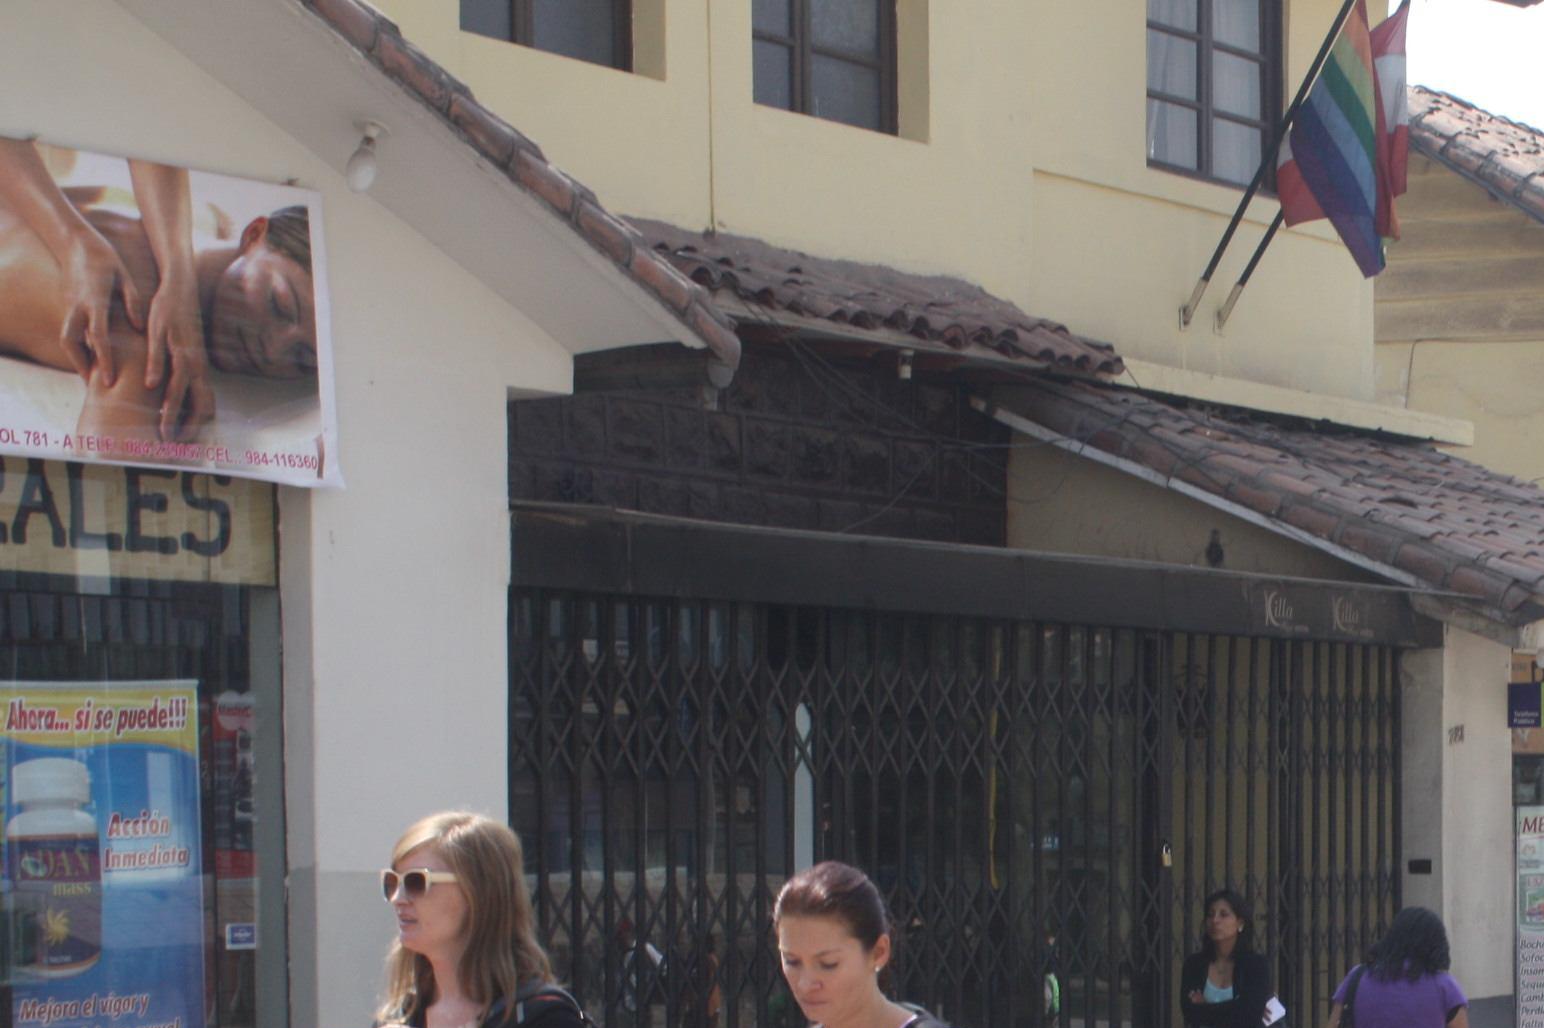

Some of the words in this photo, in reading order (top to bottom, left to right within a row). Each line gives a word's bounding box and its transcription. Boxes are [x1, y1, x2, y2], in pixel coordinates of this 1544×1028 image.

[24, 430, 48, 447] 781
[63, 434, 73, 448] A
[246, 450, 318, 470] 984-116360
[6, 698, 70, 732] Ahora...
[75, 700, 91, 731] si
[94, 708, 112, 731] se
[116, 697, 188, 736] puede!!!
[107, 810, 170, 838] Acción
[104, 845, 189, 872] Inmediata
[18, 998, 80, 1025] Mejora
[82, 993, 97, 1016] el
[136, 994, 149, 1017] y
